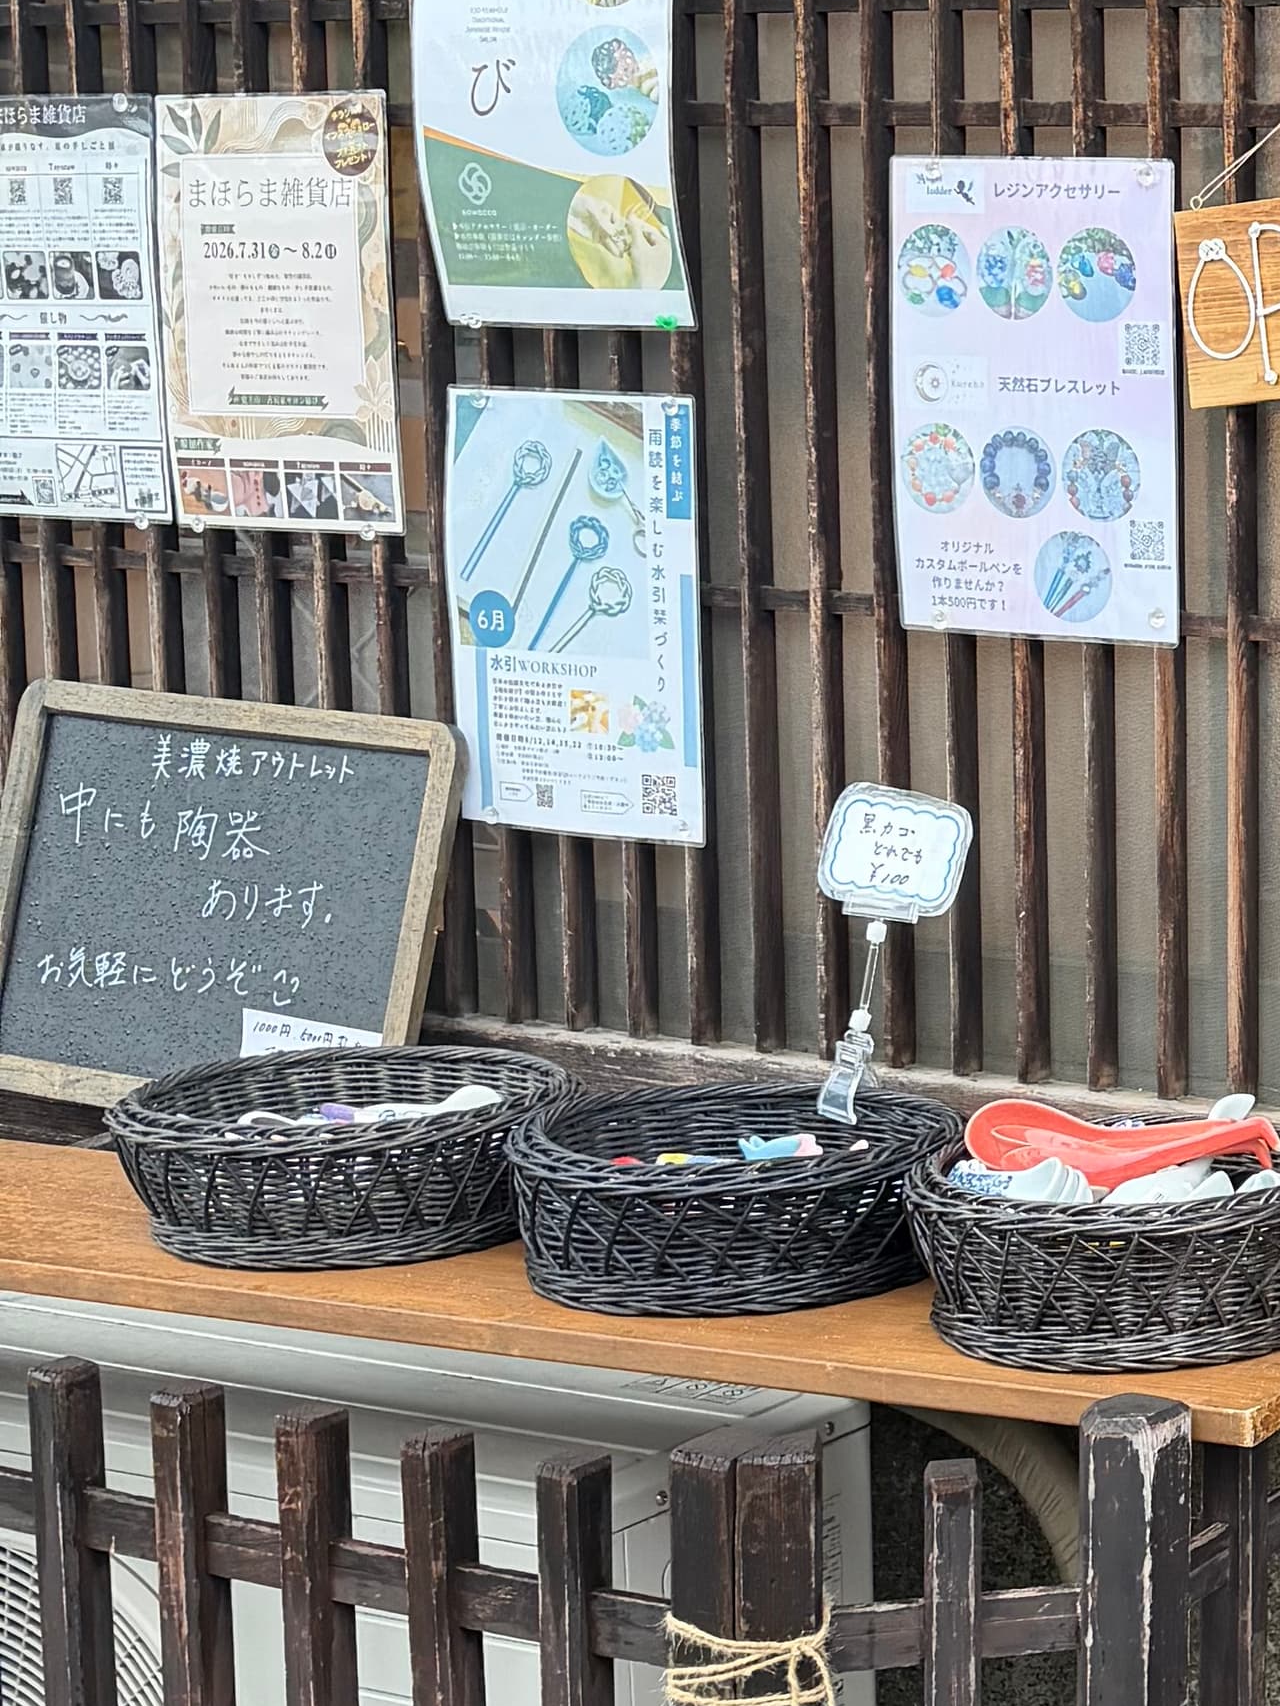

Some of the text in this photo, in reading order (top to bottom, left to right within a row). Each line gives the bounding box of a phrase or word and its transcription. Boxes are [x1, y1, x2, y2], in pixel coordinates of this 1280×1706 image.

[0, 103, 87, 125] ほらま雑貨店
[188, 177, 353, 208] まほらま雑貨店
[994, 181, 1120, 200] レジンアクセサリー
[998, 376, 1120, 396] 天然石ブレスレット
[940, 540, 994, 555] オリジナル
[915, 557, 1023, 575] カスタムボールペンを
[477, 609, 506, 634] 6月
[151, 734, 354, 784] 美濃焼アウトレット
